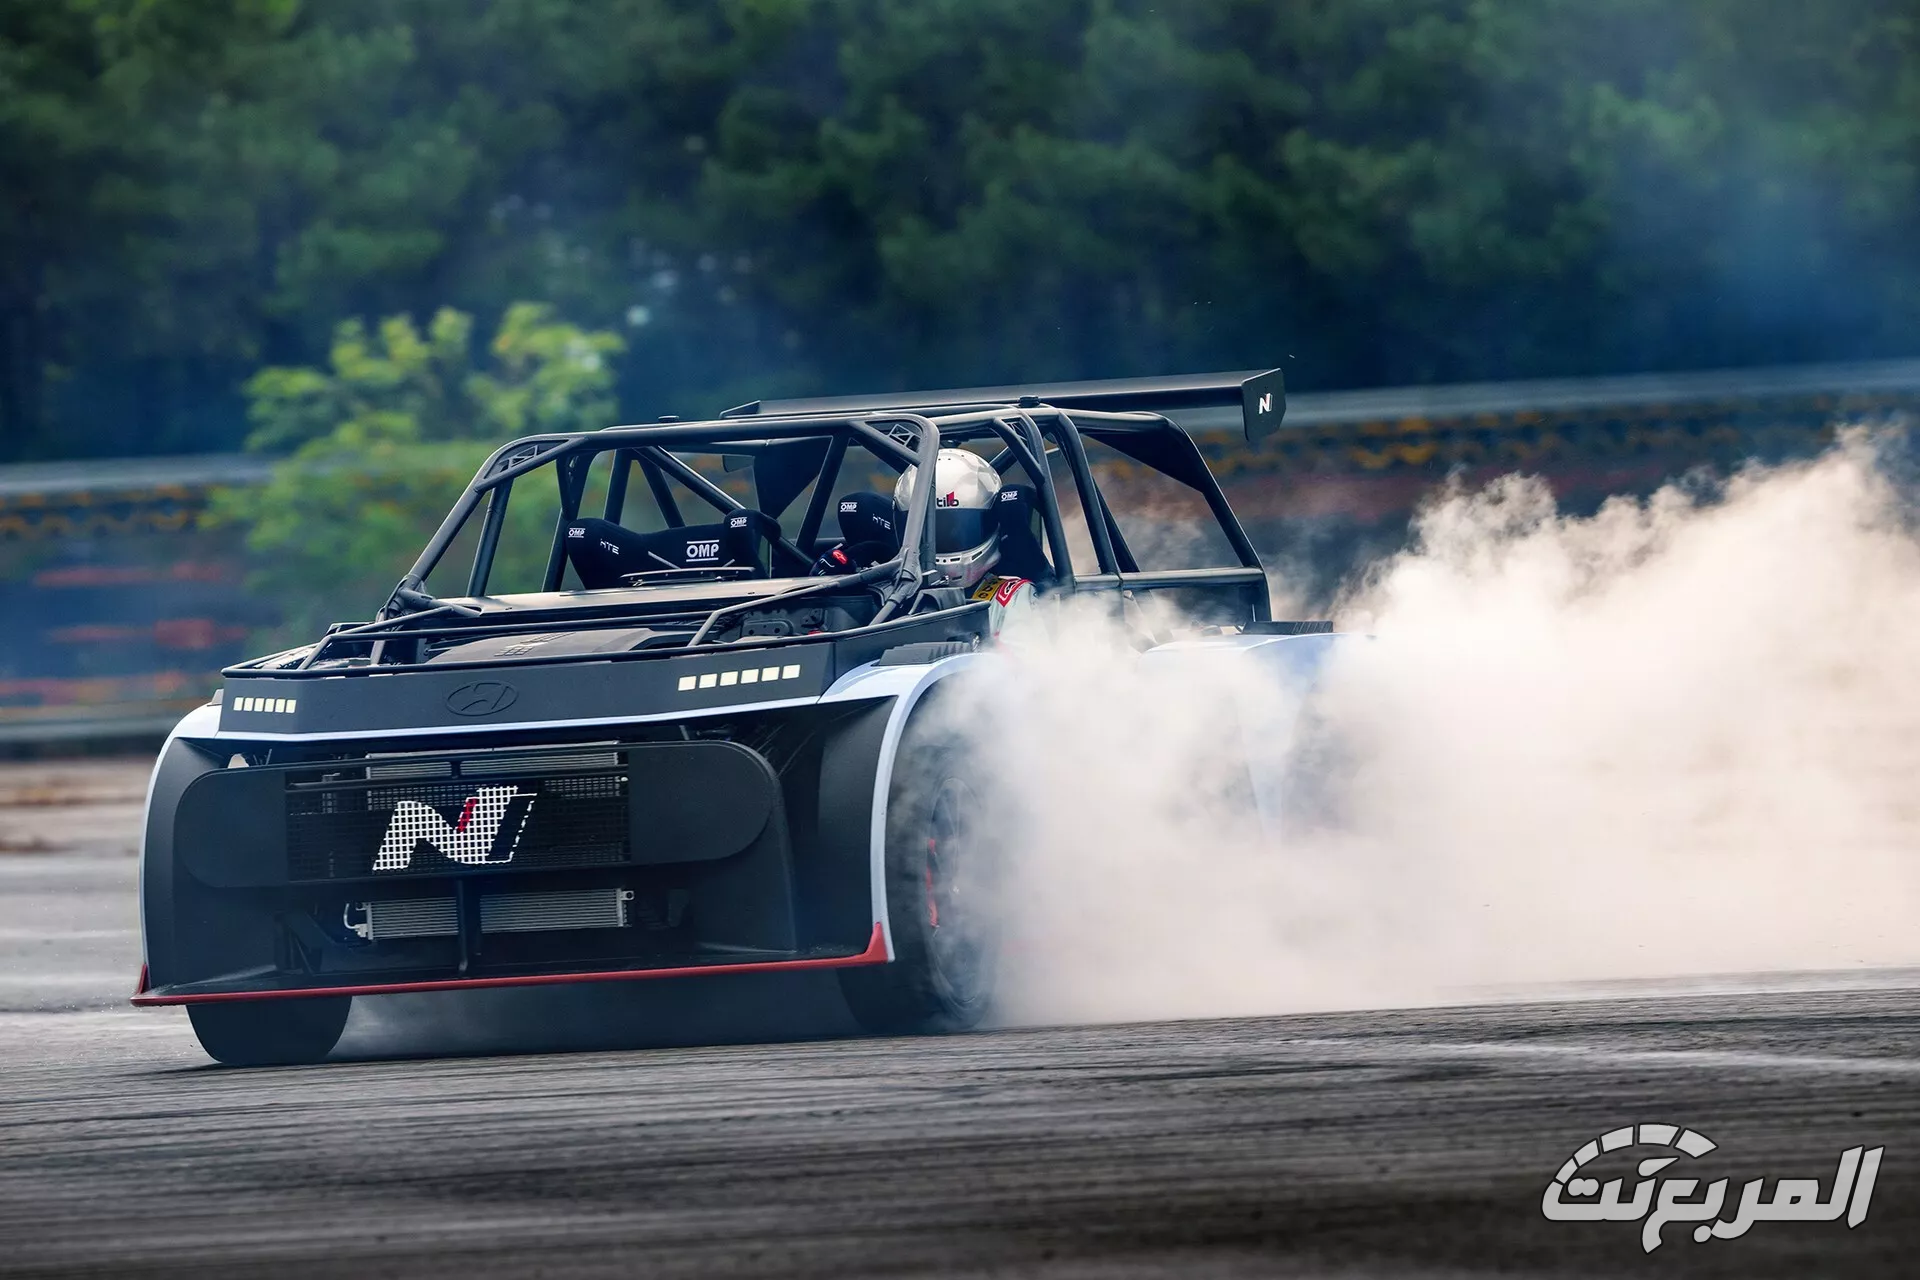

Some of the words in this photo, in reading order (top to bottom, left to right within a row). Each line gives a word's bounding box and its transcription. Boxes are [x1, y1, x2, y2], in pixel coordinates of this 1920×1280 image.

[936, 491, 960, 508] tilo
[1000, 491, 1018, 500] OMP
[840, 503, 858, 511] OMP
[730, 517, 748, 527] OMP
[568, 529, 585, 537] OMP
[686, 543, 720, 559] OMP
